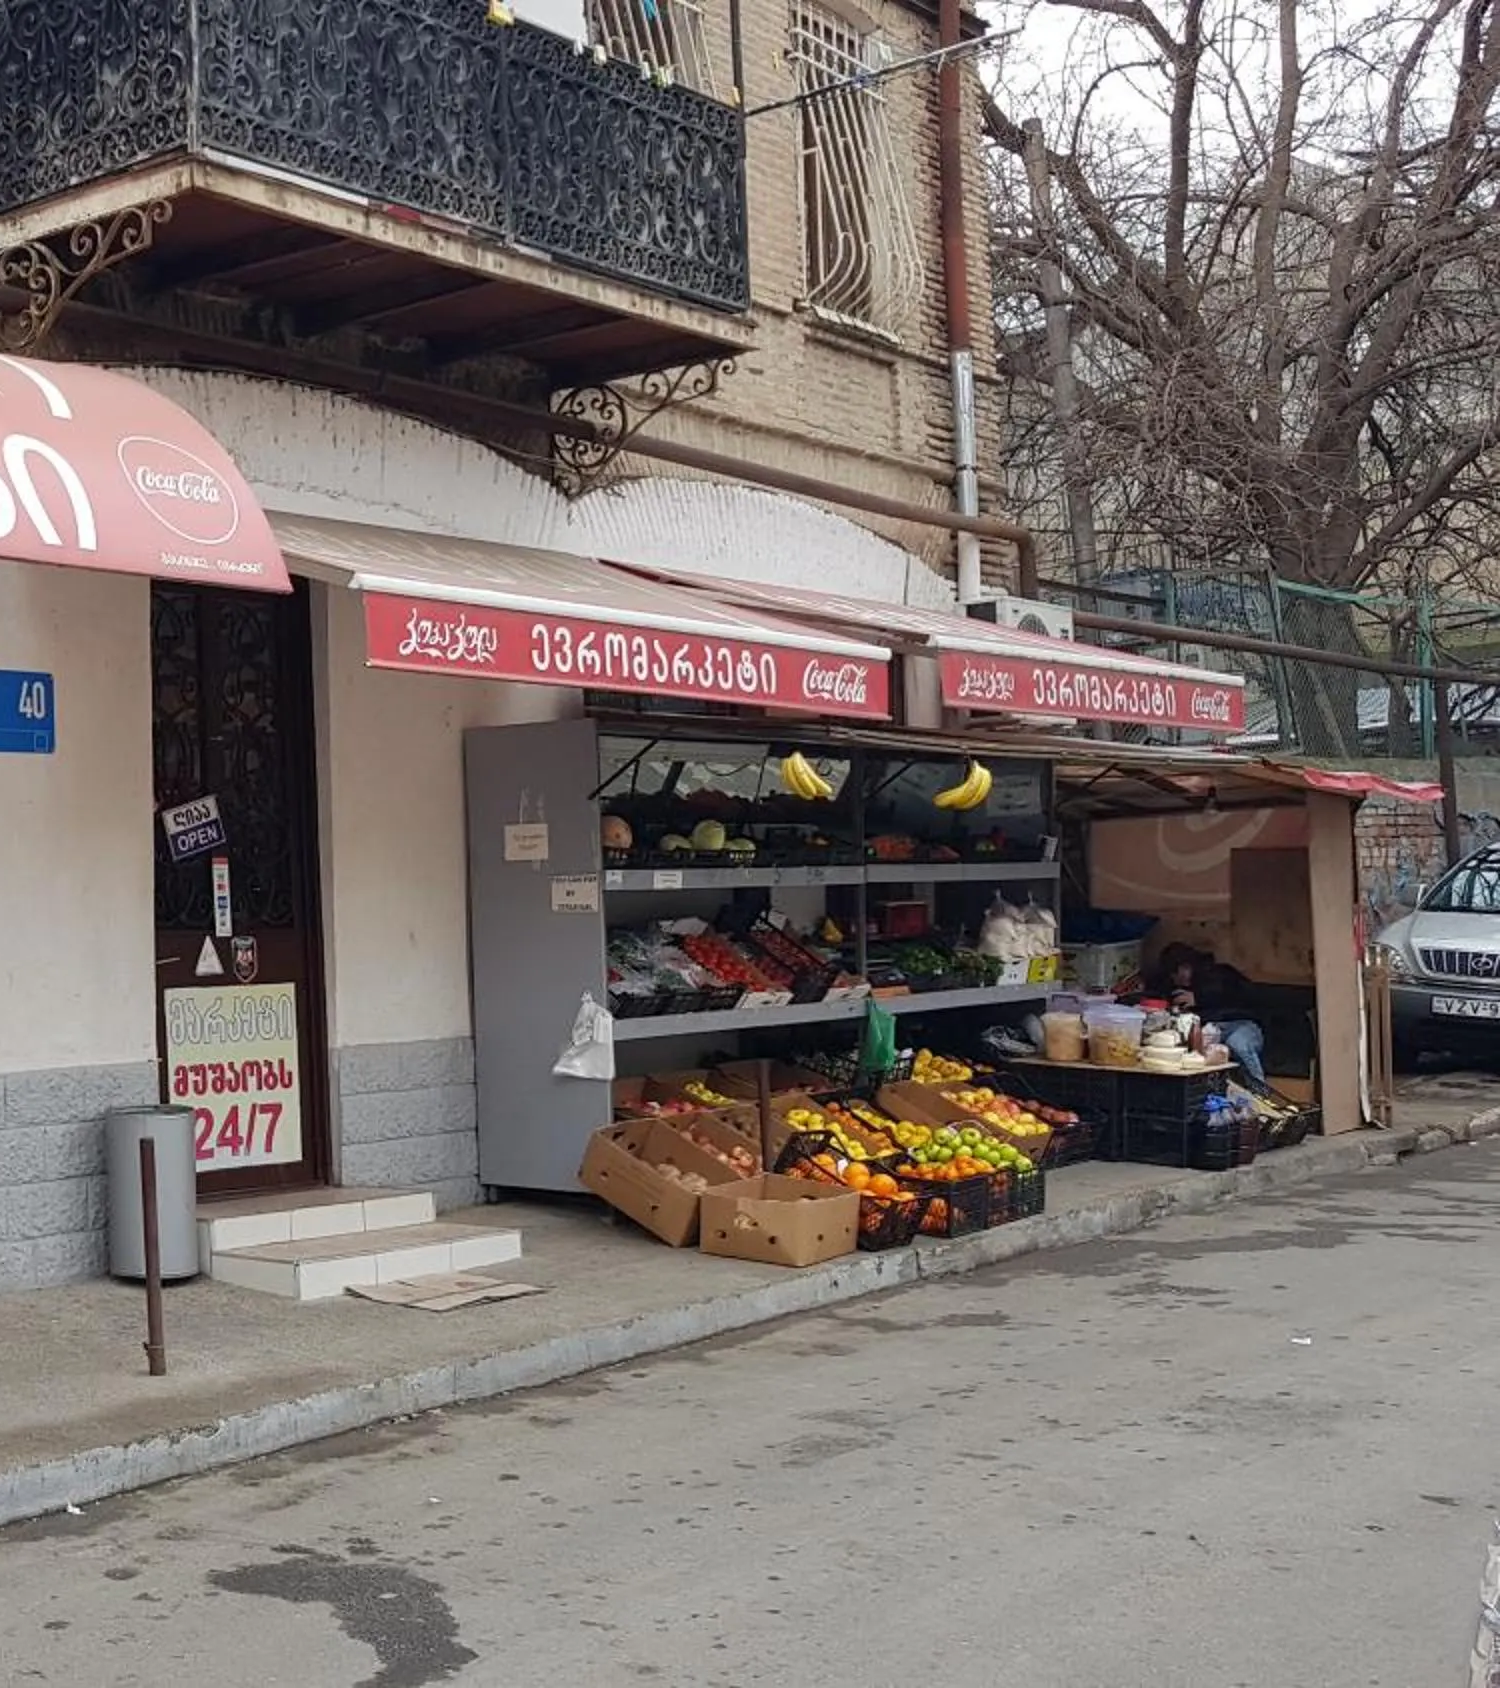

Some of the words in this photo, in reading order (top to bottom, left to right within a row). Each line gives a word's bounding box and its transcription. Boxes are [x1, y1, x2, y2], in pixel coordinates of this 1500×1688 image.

[135, 465, 221, 505] Coca-Cola
[531, 623, 778, 696] ევრომარკეტი
[802, 658, 868, 704] Coca-Cola
[19, 680, 46, 719] 40
[1033, 669, 1177, 717] ევრომარკეტი
[173, 803, 211, 828] ღიაა
[177, 823, 219, 852] OPEN
[169, 993, 294, 1046] მარკეტი
[173, 1058, 293, 1097] მუშაობს
[194, 1102, 284, 1161] 24/7
